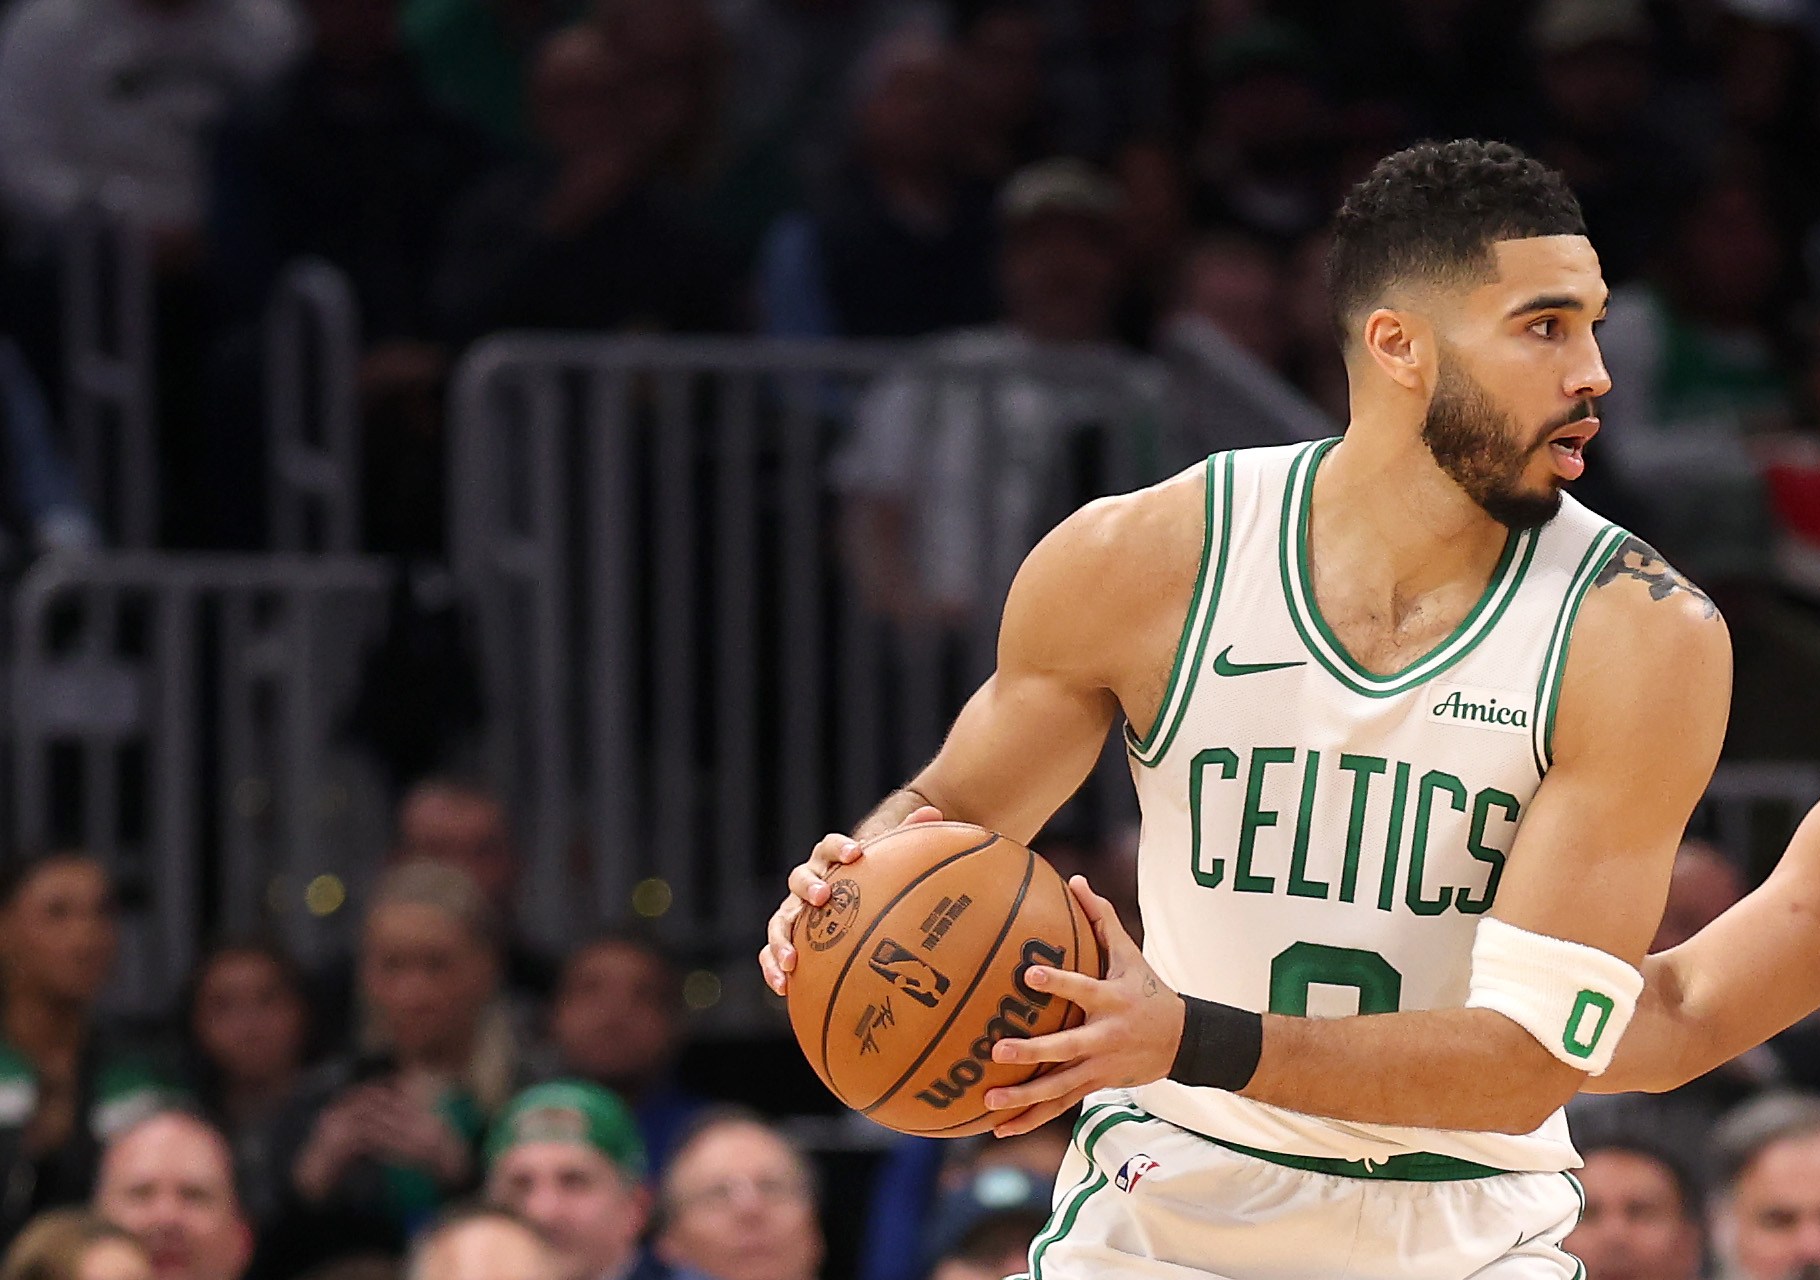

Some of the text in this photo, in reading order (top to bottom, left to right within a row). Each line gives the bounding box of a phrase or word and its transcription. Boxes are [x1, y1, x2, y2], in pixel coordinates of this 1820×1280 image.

[1432, 691, 1527, 728] Amica
[1189, 746, 1522, 917] CELTICS
[1562, 989, 1614, 1060] 0
